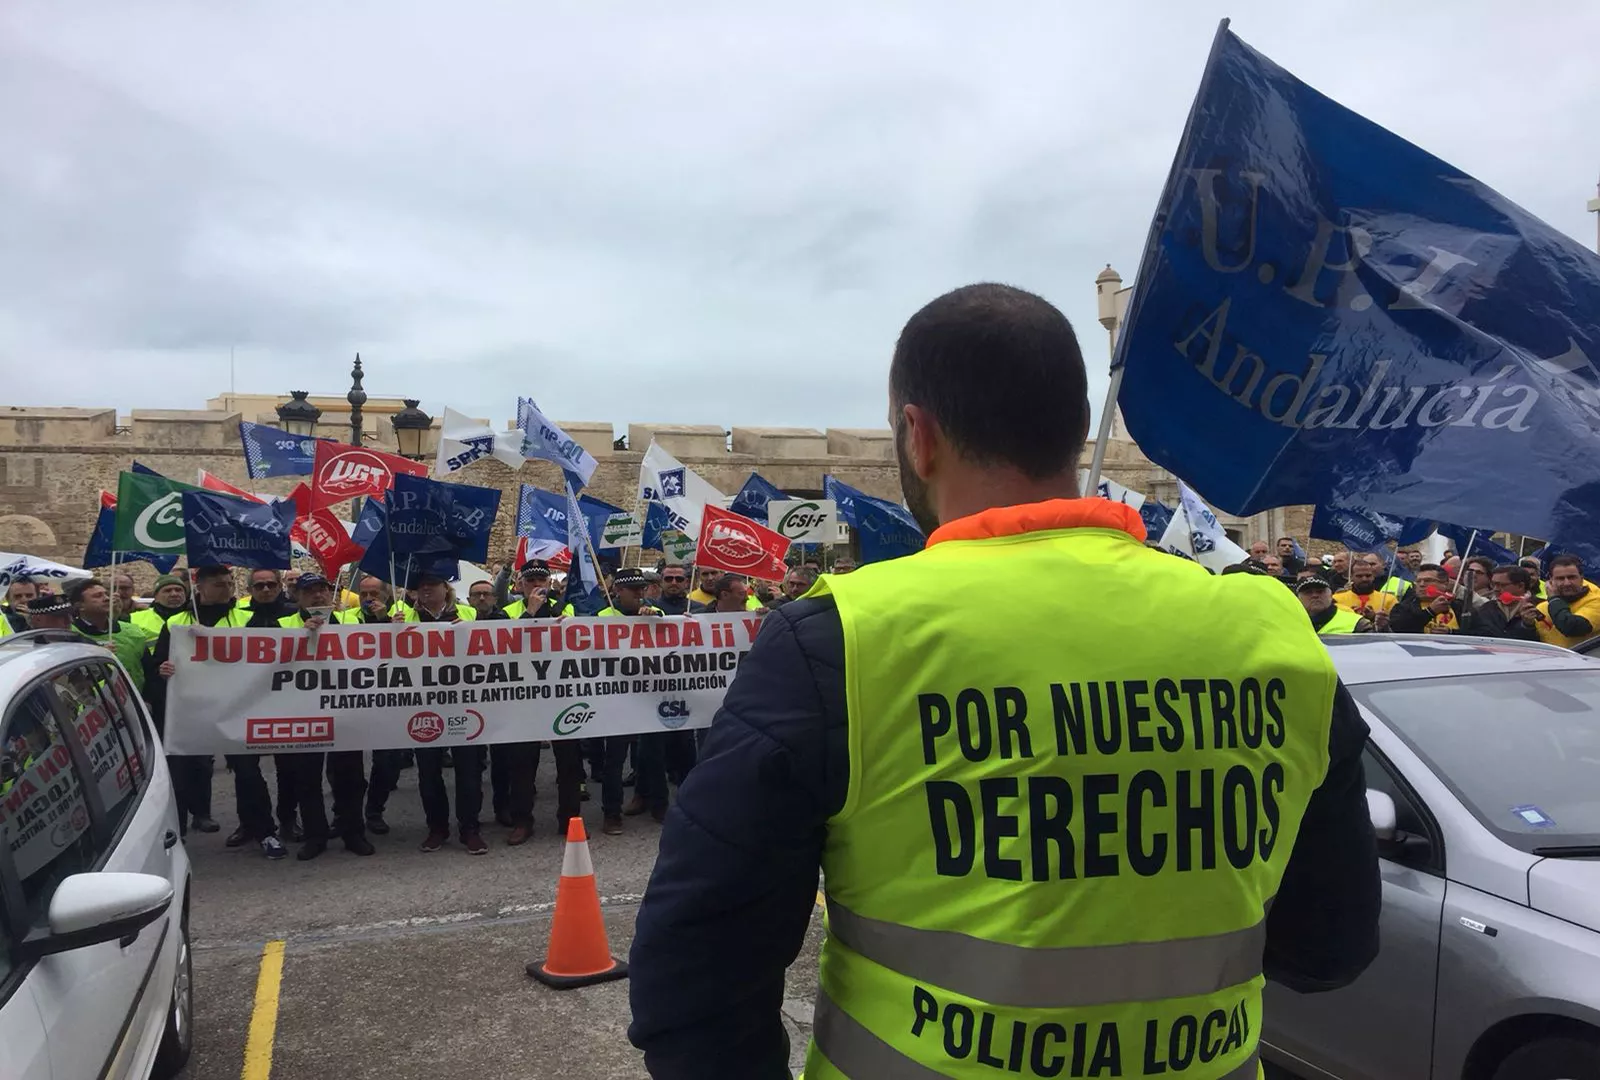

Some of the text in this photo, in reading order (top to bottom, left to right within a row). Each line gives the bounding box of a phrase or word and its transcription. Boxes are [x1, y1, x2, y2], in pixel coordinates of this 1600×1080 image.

[1174, 297, 1540, 433] Andalucía
[325, 460, 385, 490] UGT
[301, 518, 336, 552] UGT
[190, 626, 456, 664] JUBILACIÓN
[467, 621, 704, 656] ANTICIPADA
[271, 651, 749, 691] POLICÍA LOCAL Y AUTONÓMIC
[320, 673, 727, 710] PLATAFORMA POR EL ANTICIPO DE LA EDAD DE JUBILACIÓN
[658, 700, 690, 718] CSL
[253, 722, 328, 739] CCOO
[413, 715, 440, 730] UGT
[564, 711, 596, 725] CSIF
[917, 677, 1287, 765] POR NUESTROS
[925, 762, 1285, 882] DERECHOS
[911, 985, 1251, 1078] POLICIA LOCAL
